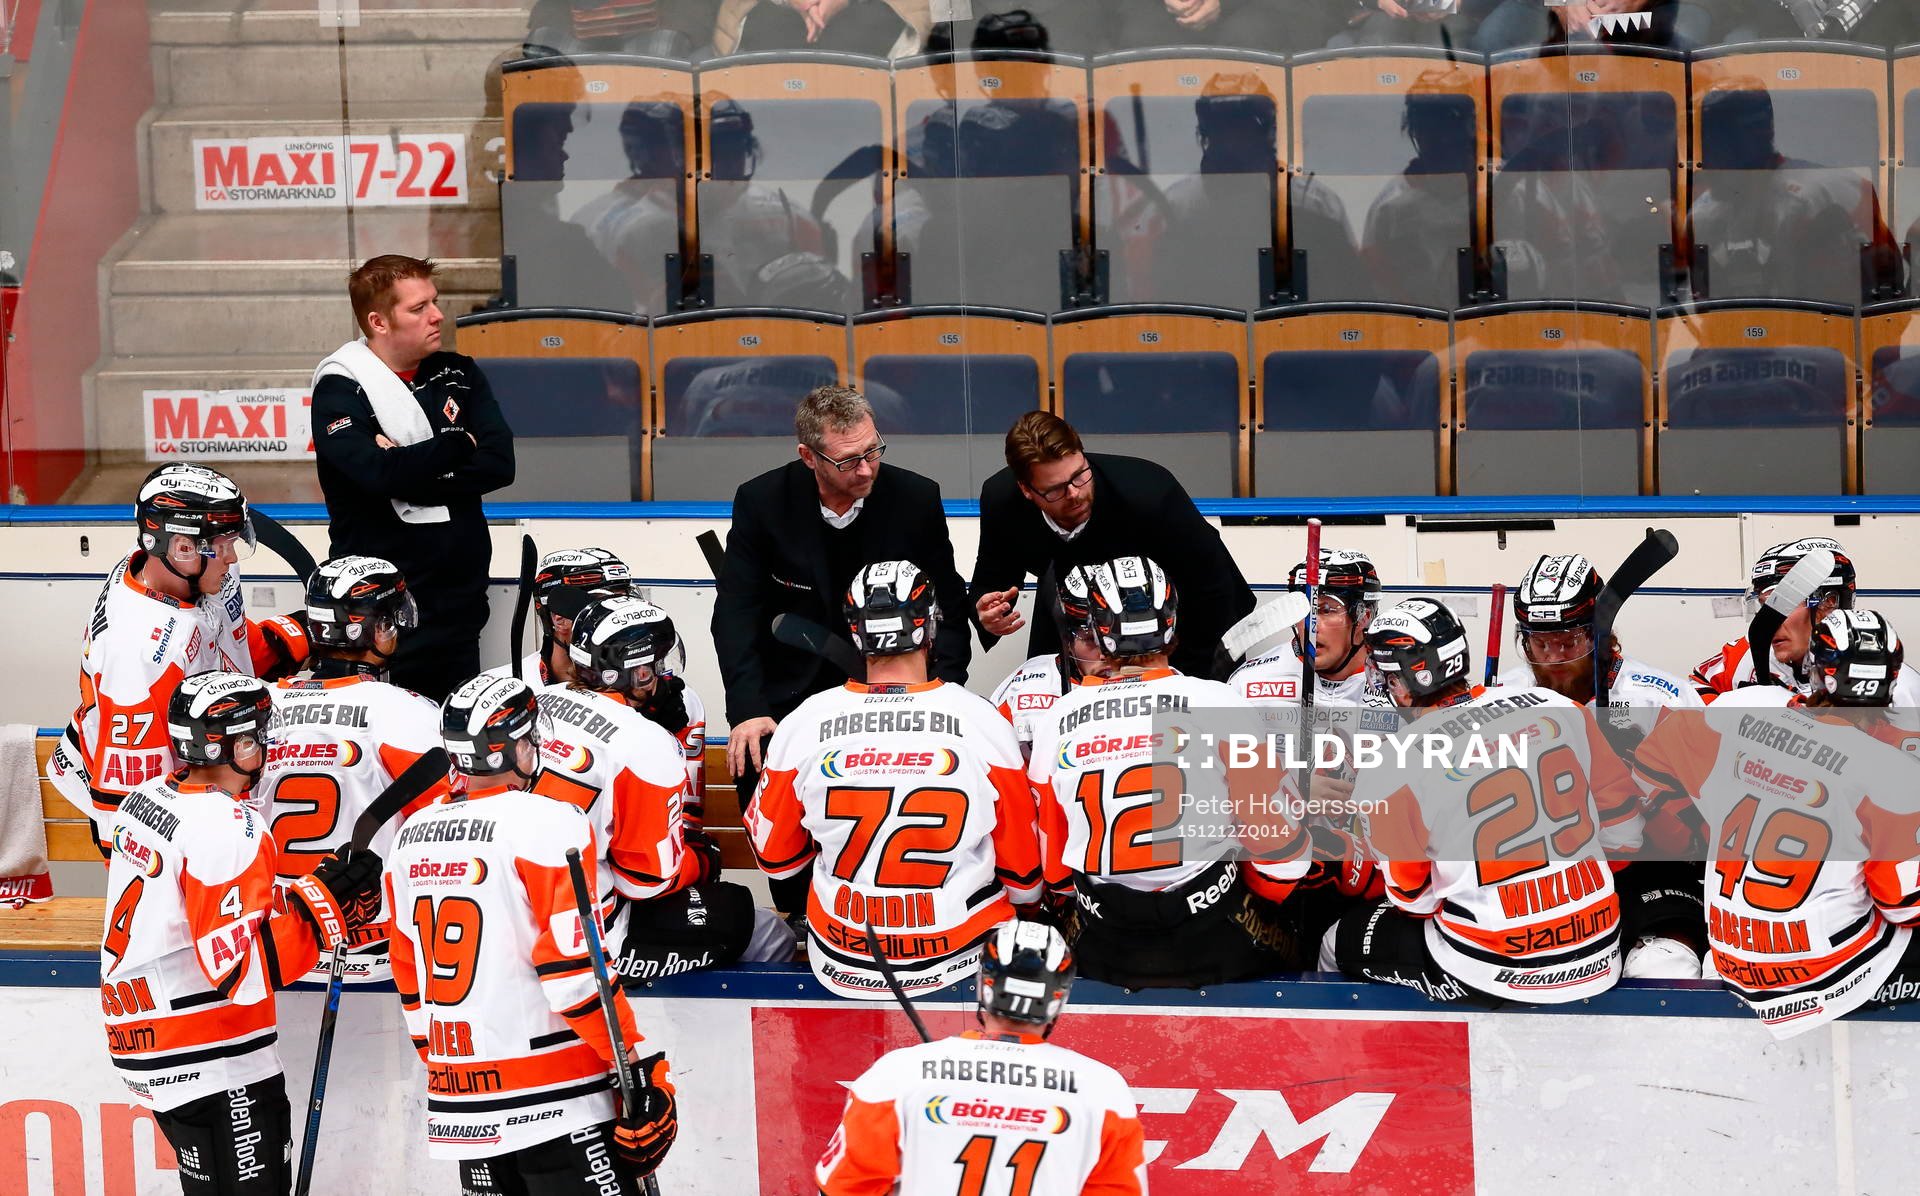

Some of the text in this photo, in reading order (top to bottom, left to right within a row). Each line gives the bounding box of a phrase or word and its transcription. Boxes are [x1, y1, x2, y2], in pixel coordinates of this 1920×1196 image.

[983, 79, 998, 87] 159
[1579, 73, 1596, 81] 162
[1781, 70, 1797, 79] 163
[285, 142, 333, 151] LINKÖPING
[203, 142, 458, 198] MAXI 7-22
[205, 188, 336, 200] ICA STORMARKNAD
[544, 338, 560, 346] 153
[742, 337, 757, 346] 154
[942, 335, 958, 343] 155
[1141, 333, 1158, 342] 156
[1343, 331, 1359, 340] 157
[1544, 330, 1560, 339] 158
[1747, 328, 1763, 337] 159
[237, 394, 285, 403] LINKÖPING
[153, 397, 287, 439] MAXI
[155, 440, 287, 453] ICA STORMARKNAD
[322, 624, 331, 638] 2
[875, 633, 897, 648] 72
[1022, 672, 1047, 682] Line
[1445, 654, 1463, 678] 29
[1642, 675, 1680, 697] STENA
[1852, 680, 1879, 696] 49
[1157, 694, 1192, 714] BIL
[1508, 693, 1549, 710] BIL
[1610, 701, 1630, 709] ARLS
[336, 705, 368, 728] BIL
[1610, 709, 1630, 718] RONA
[111, 712, 154, 746] 27
[584, 714, 620, 743] BIL
[820, 711, 963, 742] RÅBERGS BIL
[181, 742, 188, 756] 4
[1075, 734, 1164, 758] BÖRJES
[457, 754, 472, 768] 19
[845, 748, 934, 768] BÖRJES
[1812, 745, 1849, 776] BIL
[104, 754, 162, 786] ABB
[1743, 759, 1808, 793] BÖRJES
[272, 772, 341, 879] 2
[1075, 761, 1187, 876] 12
[1467, 744, 1595, 886] 29
[157, 813, 180, 842] BIL
[468, 819, 496, 842] BIL
[825, 786, 969, 890] 72
[1715, 793, 1832, 912] 49
[409, 858, 468, 878] BÖRJES
[1186, 856, 1238, 914] Reeb
[1497, 855, 1605, 919] WIKLUND
[220, 885, 243, 919] 4
[834, 884, 935, 928] ROHDIN
[103, 875, 144, 976] 4
[1505, 905, 1613, 954] stadium
[413, 895, 482, 1007] 19
[614, 949, 658, 979] eden
[947, 953, 981, 973] BAU
[1718, 953, 1810, 986] stadium
[1010, 996, 1032, 1014] 11
[428, 1065, 502, 1093] adium
[1043, 1067, 1078, 1093] BIL
[952, 1098, 1047, 1124] BÖRJES
[227, 1085, 266, 1182] eden Rock
[954, 1134, 1048, 1196] 11
